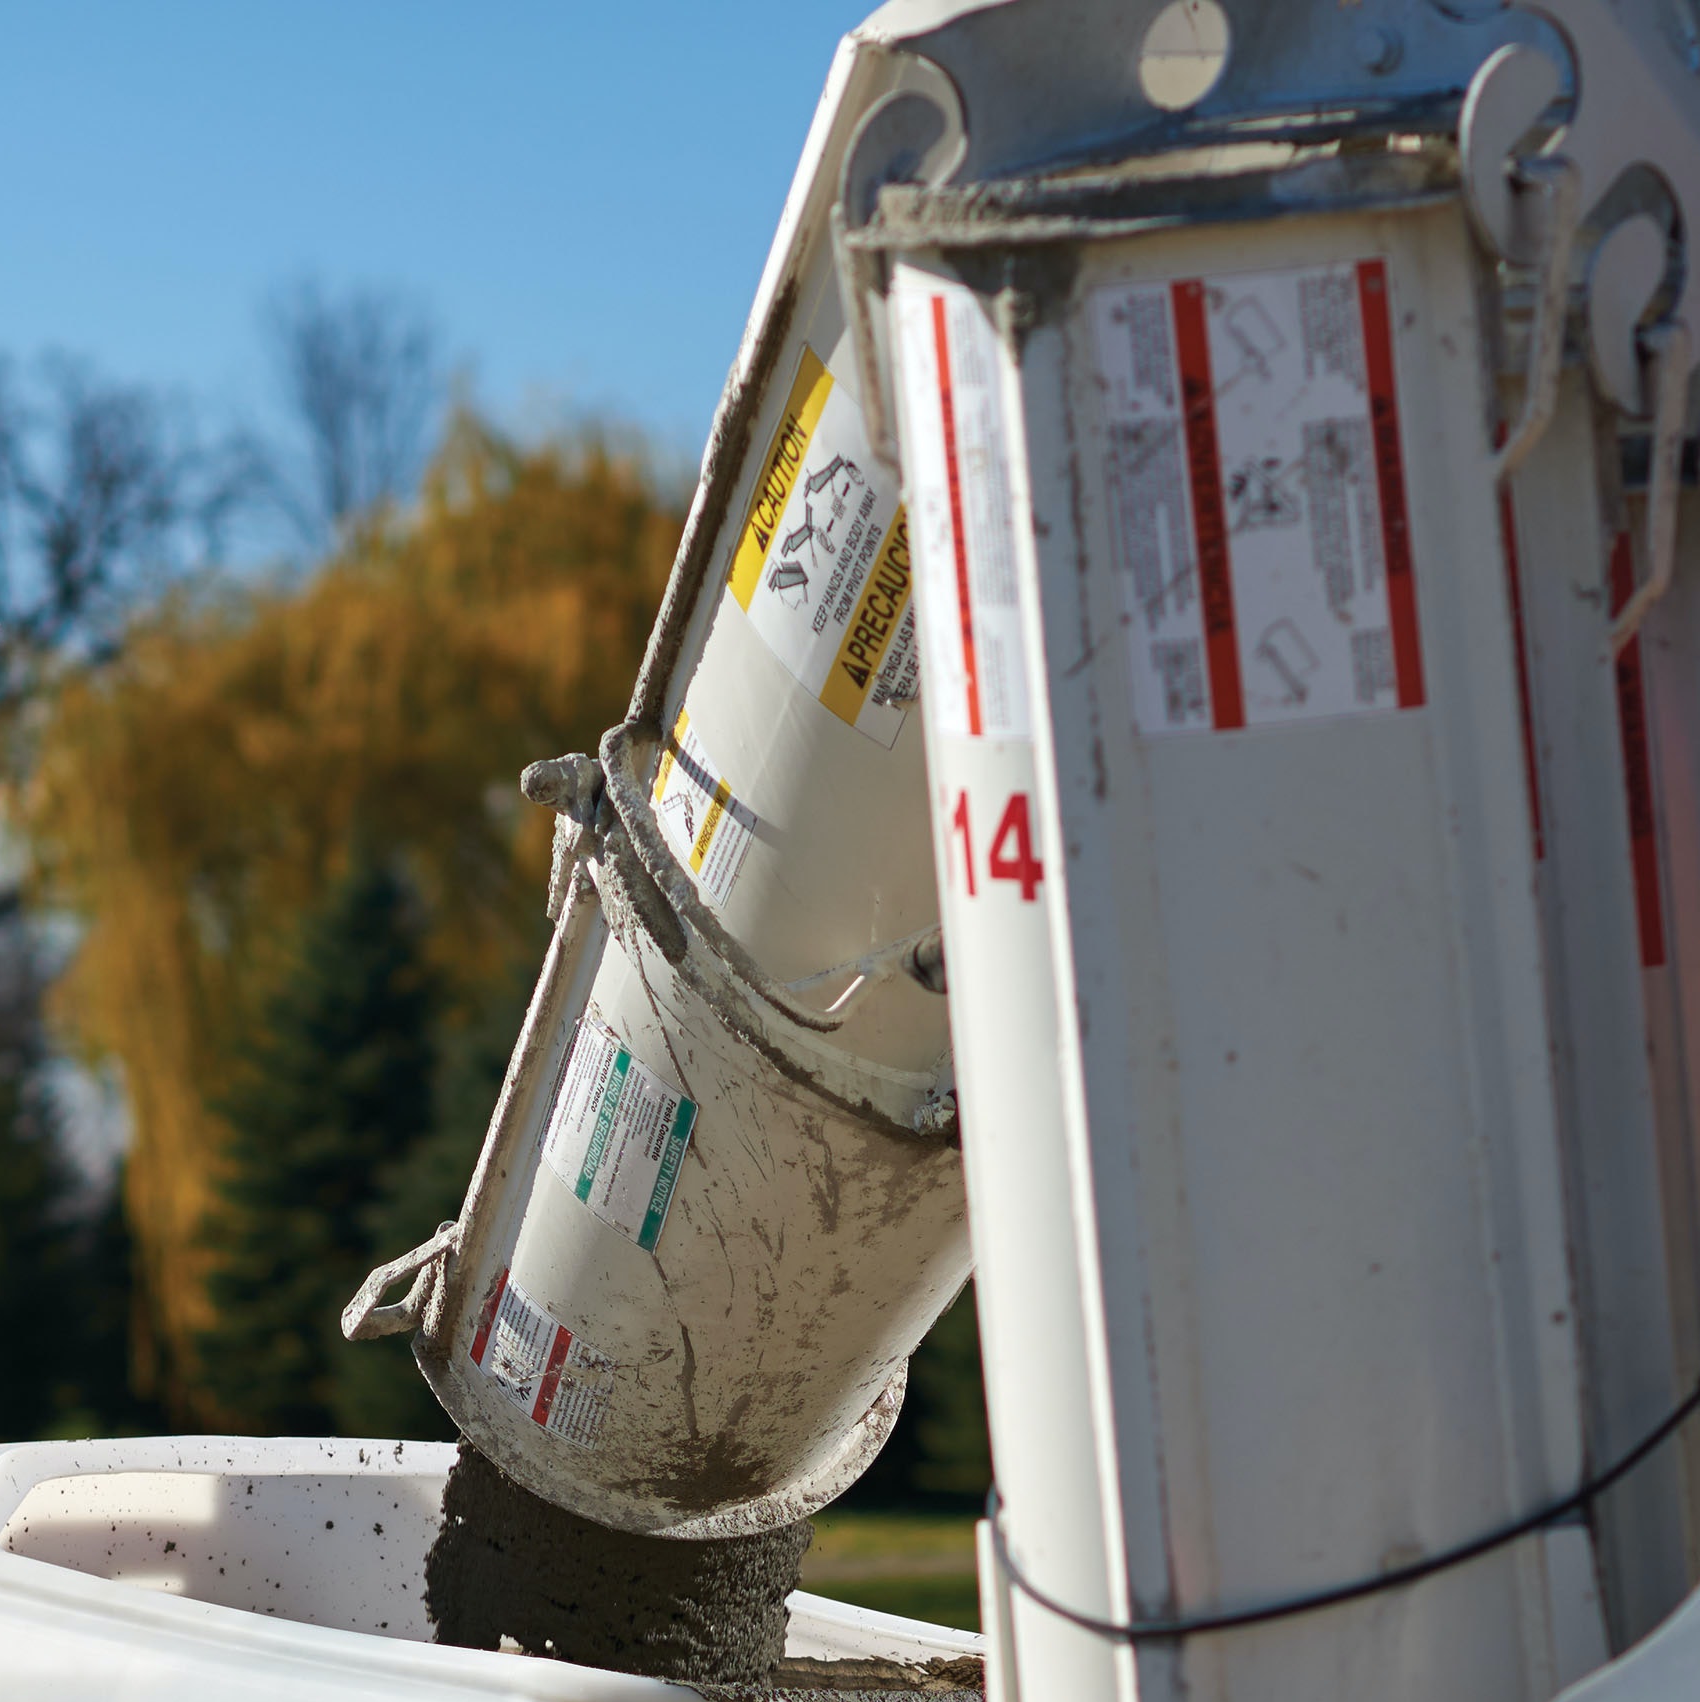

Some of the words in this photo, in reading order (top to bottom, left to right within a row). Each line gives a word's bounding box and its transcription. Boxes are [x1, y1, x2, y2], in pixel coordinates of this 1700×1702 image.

[756, 413, 808, 529] CAUTION
[811, 603, 829, 637] KEEP
[822, 567, 843, 611] HANDS
[837, 546, 852, 574] AND
[846, 516, 864, 551] BODY
[858, 484, 877, 522] AWAY
[834, 589, 853, 627] FROM
[846, 557, 866, 597] PIVOT
[859, 521, 882, 567] POINTS
[847, 514, 911, 668] PRECAUCIO
[606, 1066, 624, 1102] AVISO
[601, 1100, 613, 1119] DE
[662, 1097, 676, 1125] Fresh
[581, 1115, 609, 1181] SEGURIDAD
[650, 1121, 668, 1163] Concrete
[661, 1133, 682, 1178] SAFETY
[649, 1173, 670, 1217] NOTICE
